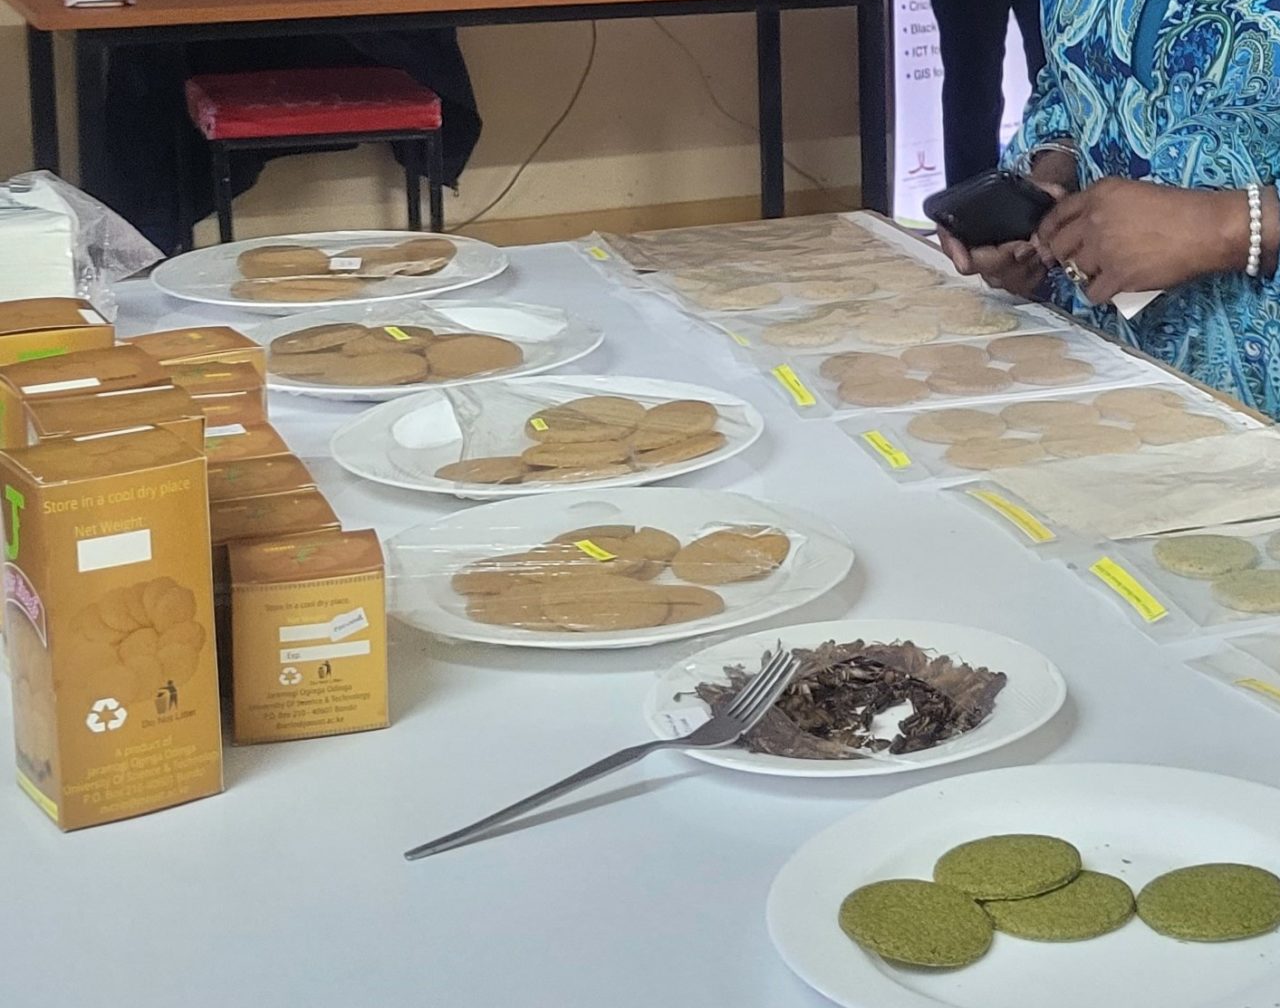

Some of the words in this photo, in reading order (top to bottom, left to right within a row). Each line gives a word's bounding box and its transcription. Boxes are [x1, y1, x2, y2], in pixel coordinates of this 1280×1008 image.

[912, 45, 928, 57] ICT
[913, 68, 931, 80] GIS
[43, 498, 79, 514] Store
[81, 496, 94, 508] in
[96, 495, 105, 506] a
[107, 488, 134, 504] cool
[138, 486, 158, 500] dry
[160, 478, 191, 496] place
[74, 525, 97, 538] Net
[141, 719, 156, 729] Do
[157, 714, 174, 724] Not
